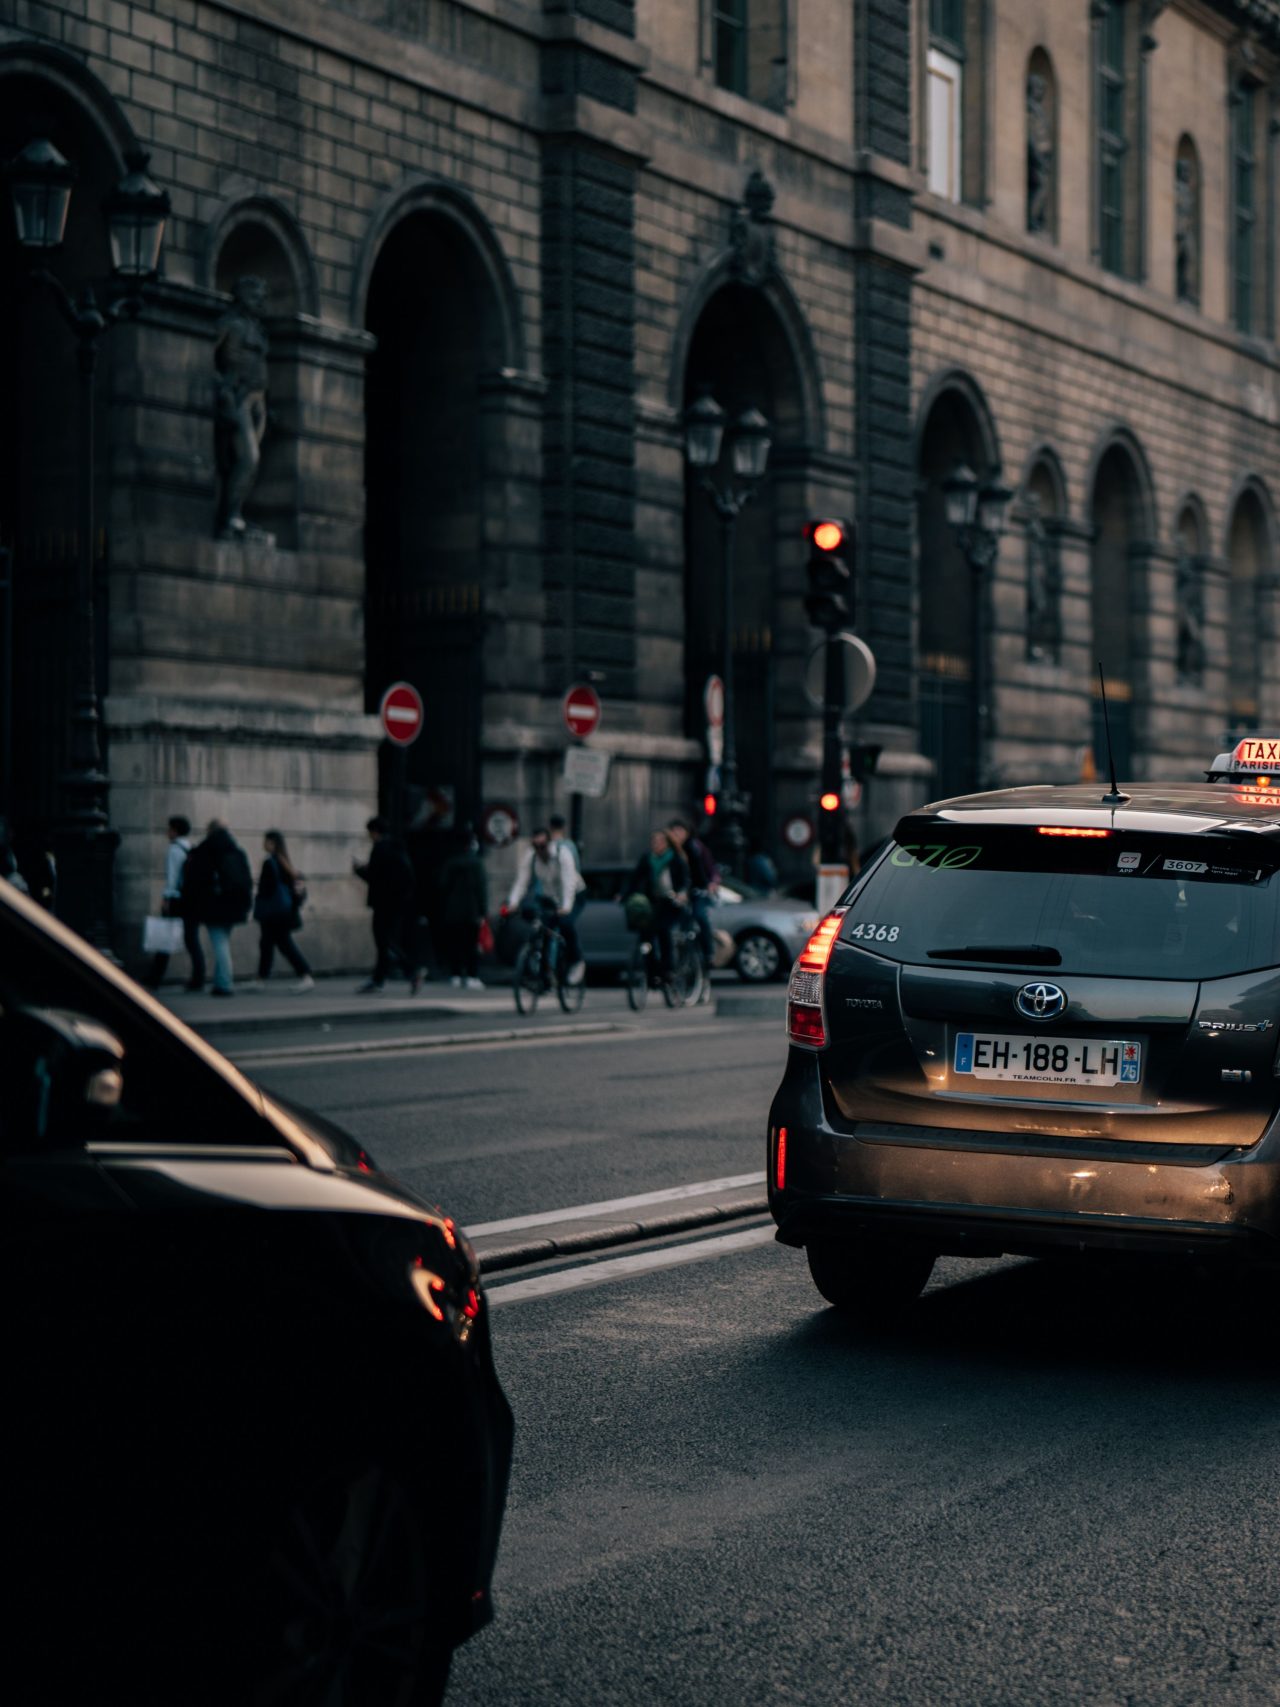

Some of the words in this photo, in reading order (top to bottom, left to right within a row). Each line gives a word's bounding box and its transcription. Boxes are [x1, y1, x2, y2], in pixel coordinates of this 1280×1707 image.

[1168, 860, 1203, 872] 3607
[852, 923, 900, 942] 4368
[845, 998, 882, 1008] TOYOTA
[961, 1057, 967, 1066] F
[974, 1040, 1119, 1075] EH-188-LH
[1122, 1064, 1136, 1079] 75
[1013, 1074, 1077, 1083] TEAMCOLIN.FR
